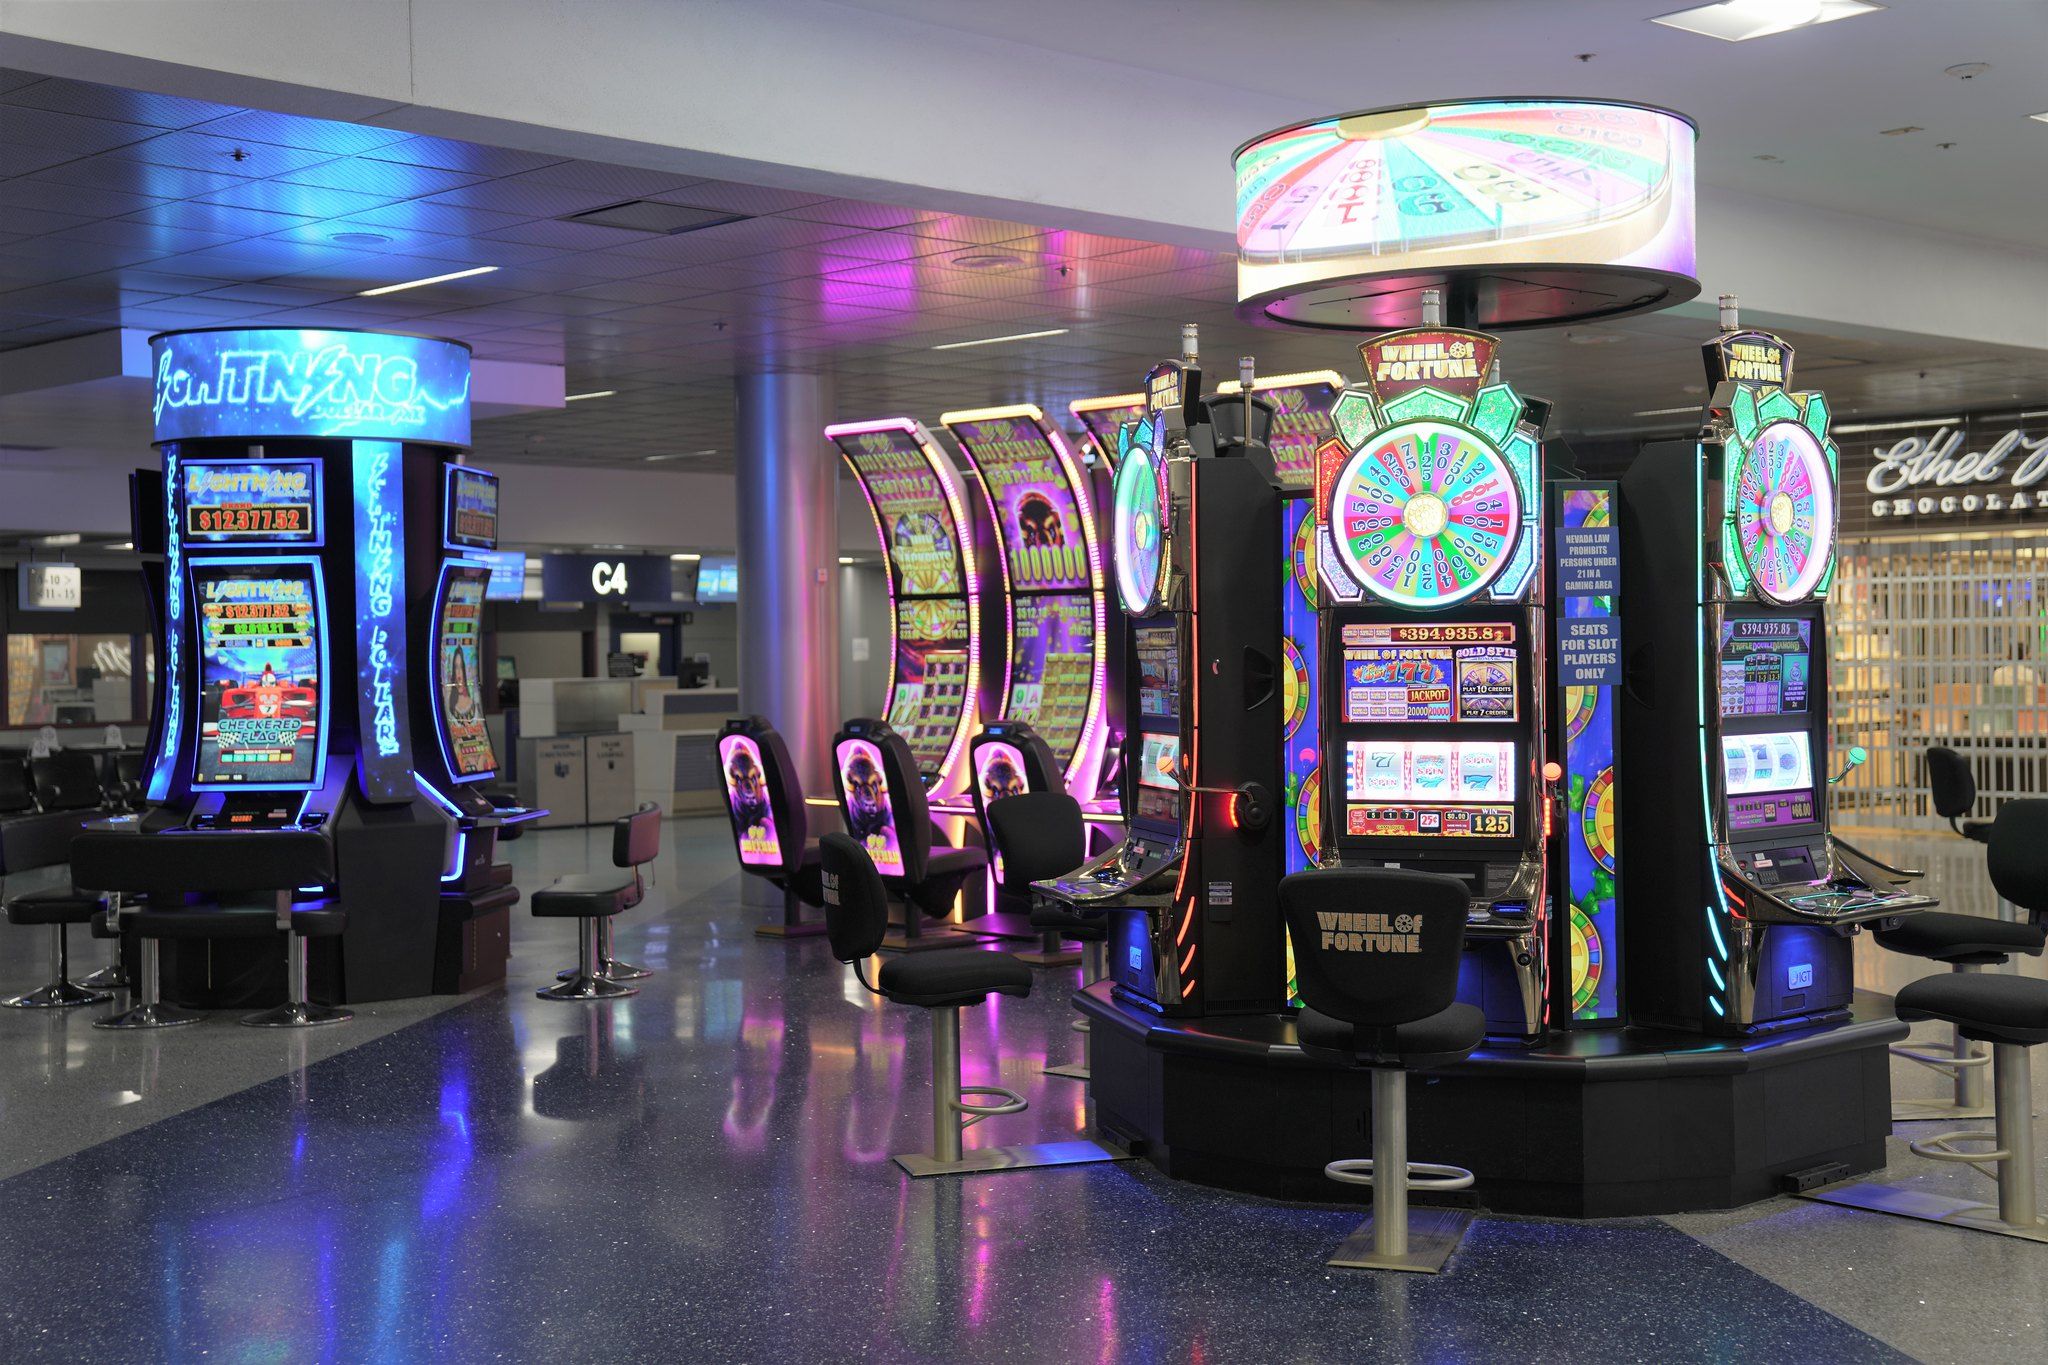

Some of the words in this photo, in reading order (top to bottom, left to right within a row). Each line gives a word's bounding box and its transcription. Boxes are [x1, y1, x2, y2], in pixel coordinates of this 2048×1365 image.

[1381, 343, 1449, 361] WHEEL
[1732, 344, 1768, 363] WHEEL
[1377, 359, 1481, 381] FORTUNE
[1729, 359, 1783, 382] FORTUNE
[152, 344, 419, 426] IGHTNING
[1401, 443, 1417, 470] 75
[1422, 442, 1432, 480] 125
[1437, 443, 1452, 469] 30
[1866, 426, 2003, 494] Ethel
[1370, 465, 1391, 486] 40
[1384, 453, 1410, 488] 250
[1444, 451, 1468, 485] 150
[1462, 462, 1486, 484] 25
[187, 469, 307, 498] LIGHTNING
[1451, 479, 1498, 506] 1000
[1358, 484, 1394, 504] 100
[1352, 502, 1379, 514] 50
[1476, 500, 1502, 512] 40
[1352, 518, 1392, 531] 500
[1463, 516, 1503, 527] 100
[1358, 533, 1384, 550] 30
[1472, 532, 1498, 549] 50
[1566, 534, 1593, 543] NEVADA
[1594, 534, 1610, 543] LAW
[1454, 537, 1487, 567] 200
[1569, 546, 1607, 555] PROHIBITS
[1010, 544, 1087, 581] 1000000
[1383, 555, 1404, 580] 75
[1404, 550, 1420, 588] 100
[1434, 549, 1452, 588] 400
[1452, 556, 1472, 580] 20
[1560, 558, 1593, 567] PERSONS
[1594, 557, 1617, 567] UNDER
[592, 561, 628, 595] C4
[1421, 563, 1432, 590] 25
[1577, 570, 1586, 579] 21
[1586, 570, 1595, 579] IN
[1596, 570, 1601, 578] A
[1565, 581, 1594, 591] GAMING
[1595, 580, 1613, 590] AREA
[1570, 624, 1608, 636] SEATS
[1456, 647, 1486, 658] GOLD
[1487, 646, 1517, 658] SPIN
[1562, 639, 1586, 651] FOR
[1588, 638, 1617, 650] SLOT
[1564, 652, 1616, 665] PLAYERS
[1575, 668, 1605, 680] ONLY
[1016, 689, 1025, 703] 9
[1411, 690, 1446, 701] JACKPOT
[1477, 685, 1487, 693] 10
[218, 718, 302, 731] CHECKERED
[240, 731, 277, 742] FLAG
[1421, 815, 1437, 825] 25¢
[1475, 816, 1509, 832] 125
[1316, 911, 1394, 933] WHEEL
[1321, 931, 1422, 953] FORTUNE
